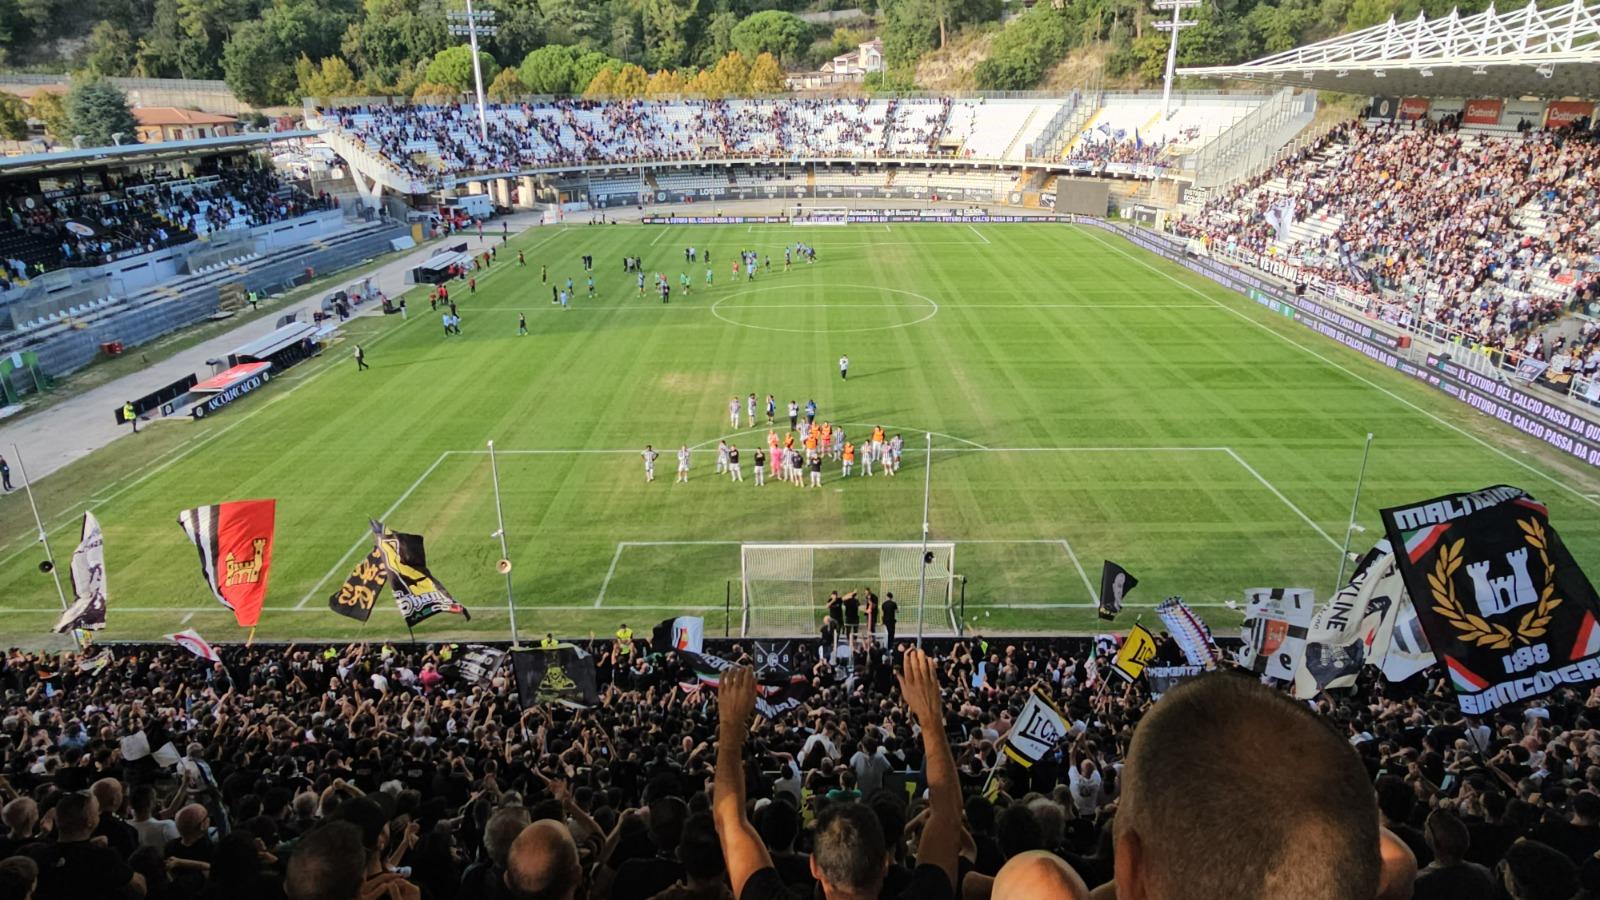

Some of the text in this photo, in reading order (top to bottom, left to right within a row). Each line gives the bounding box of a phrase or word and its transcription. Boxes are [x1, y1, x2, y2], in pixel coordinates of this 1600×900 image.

[1458, 368, 1466, 381] IL
[1466, 372, 1496, 394] FUTURO
[1496, 382, 1511, 401] DEL
[1512, 391, 1543, 414] CALCIO
[1542, 403, 1570, 427] PASSA
[1571, 419, 1585, 434] DA
[1459, 389, 1467, 402] IL
[1467, 392, 1497, 415] FUTURO
[1496, 405, 1512, 424] DEL
[1512, 414, 1544, 438] CALCIO
[1544, 428, 1573, 452] PASSA
[1574, 443, 1587, 460] DA
[1457, 655, 1600, 715] BIANCONER
